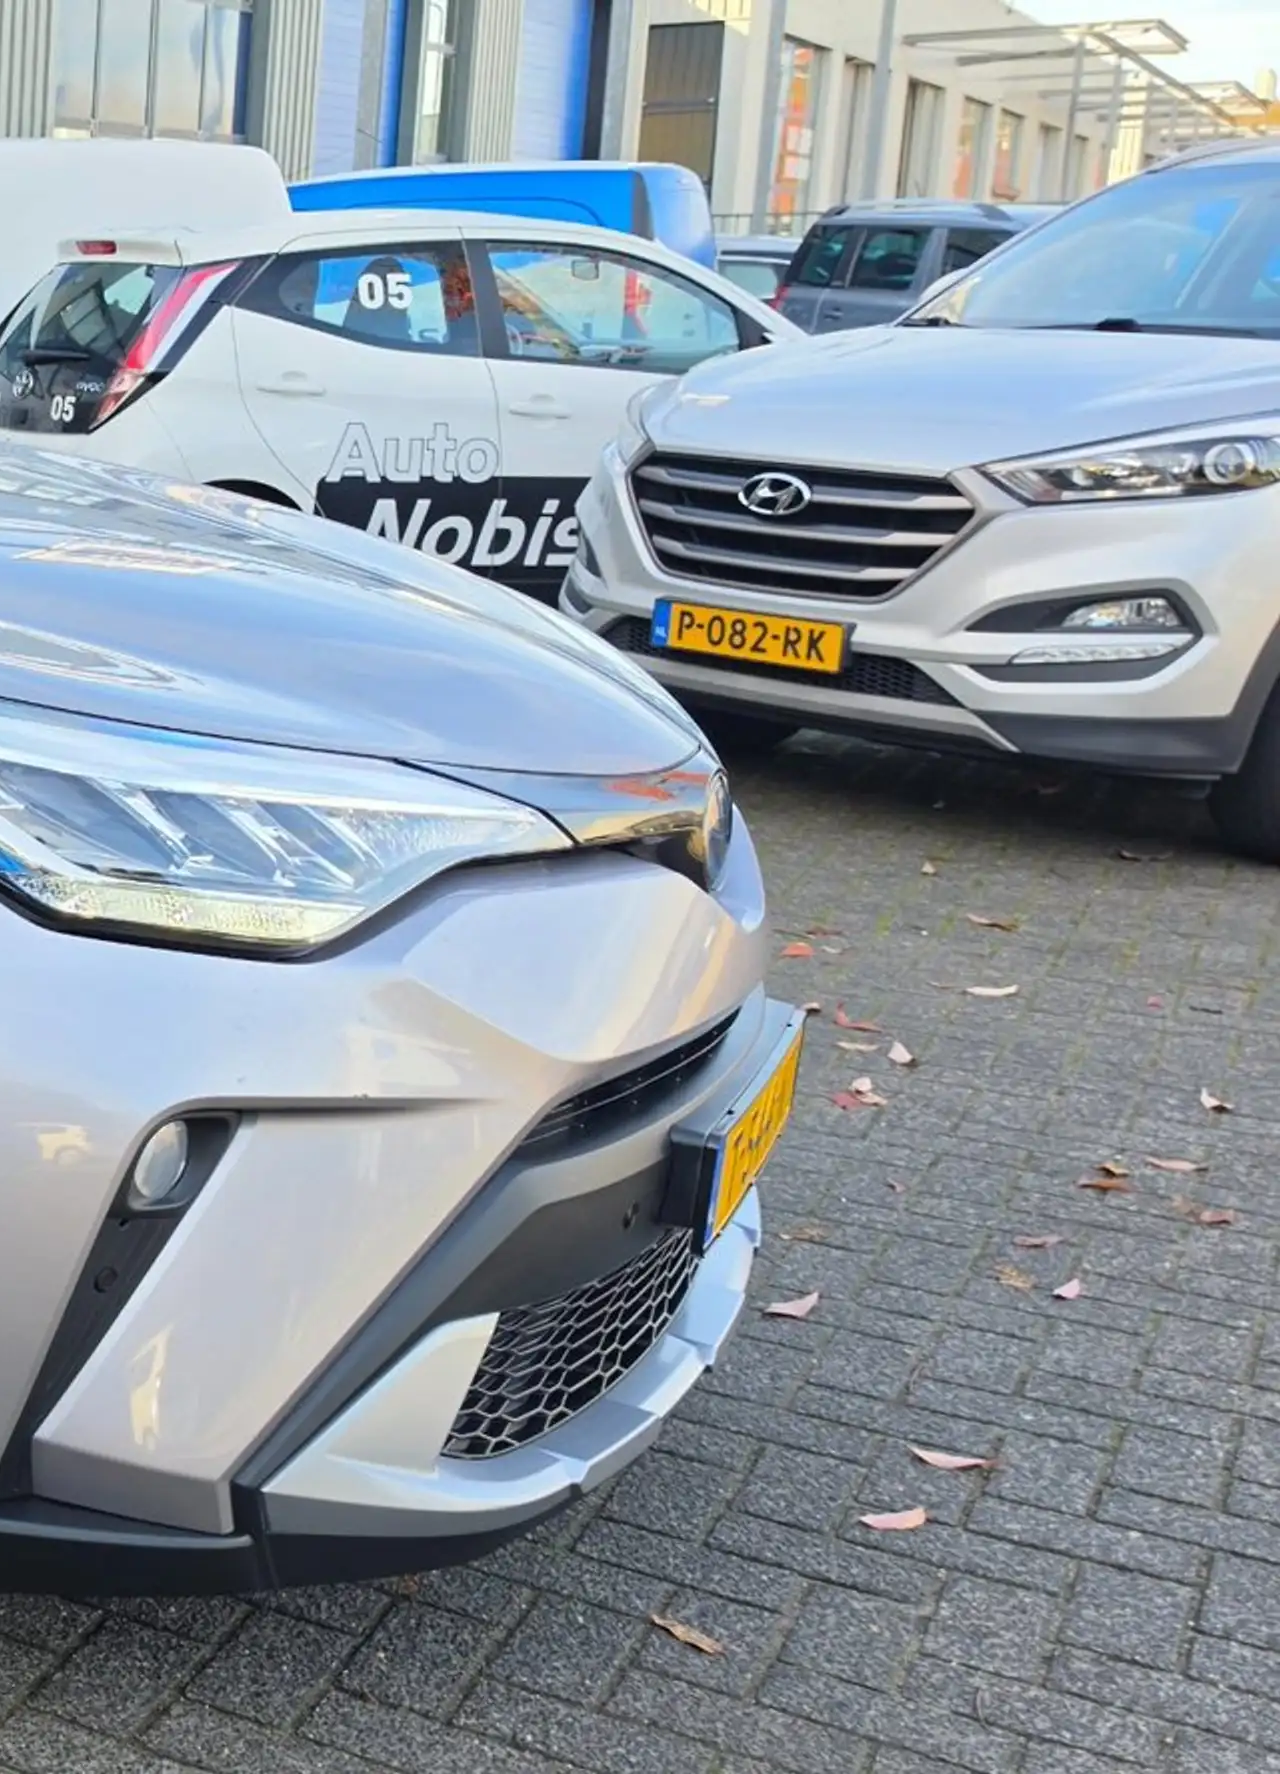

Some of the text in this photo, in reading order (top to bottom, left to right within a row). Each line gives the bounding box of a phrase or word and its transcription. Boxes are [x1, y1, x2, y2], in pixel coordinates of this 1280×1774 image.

[357, 272, 414, 310] 05
[50, 394, 77, 423] 05
[324, 421, 500, 484] Auto
[676, 610, 827, 664] P-082-RK
